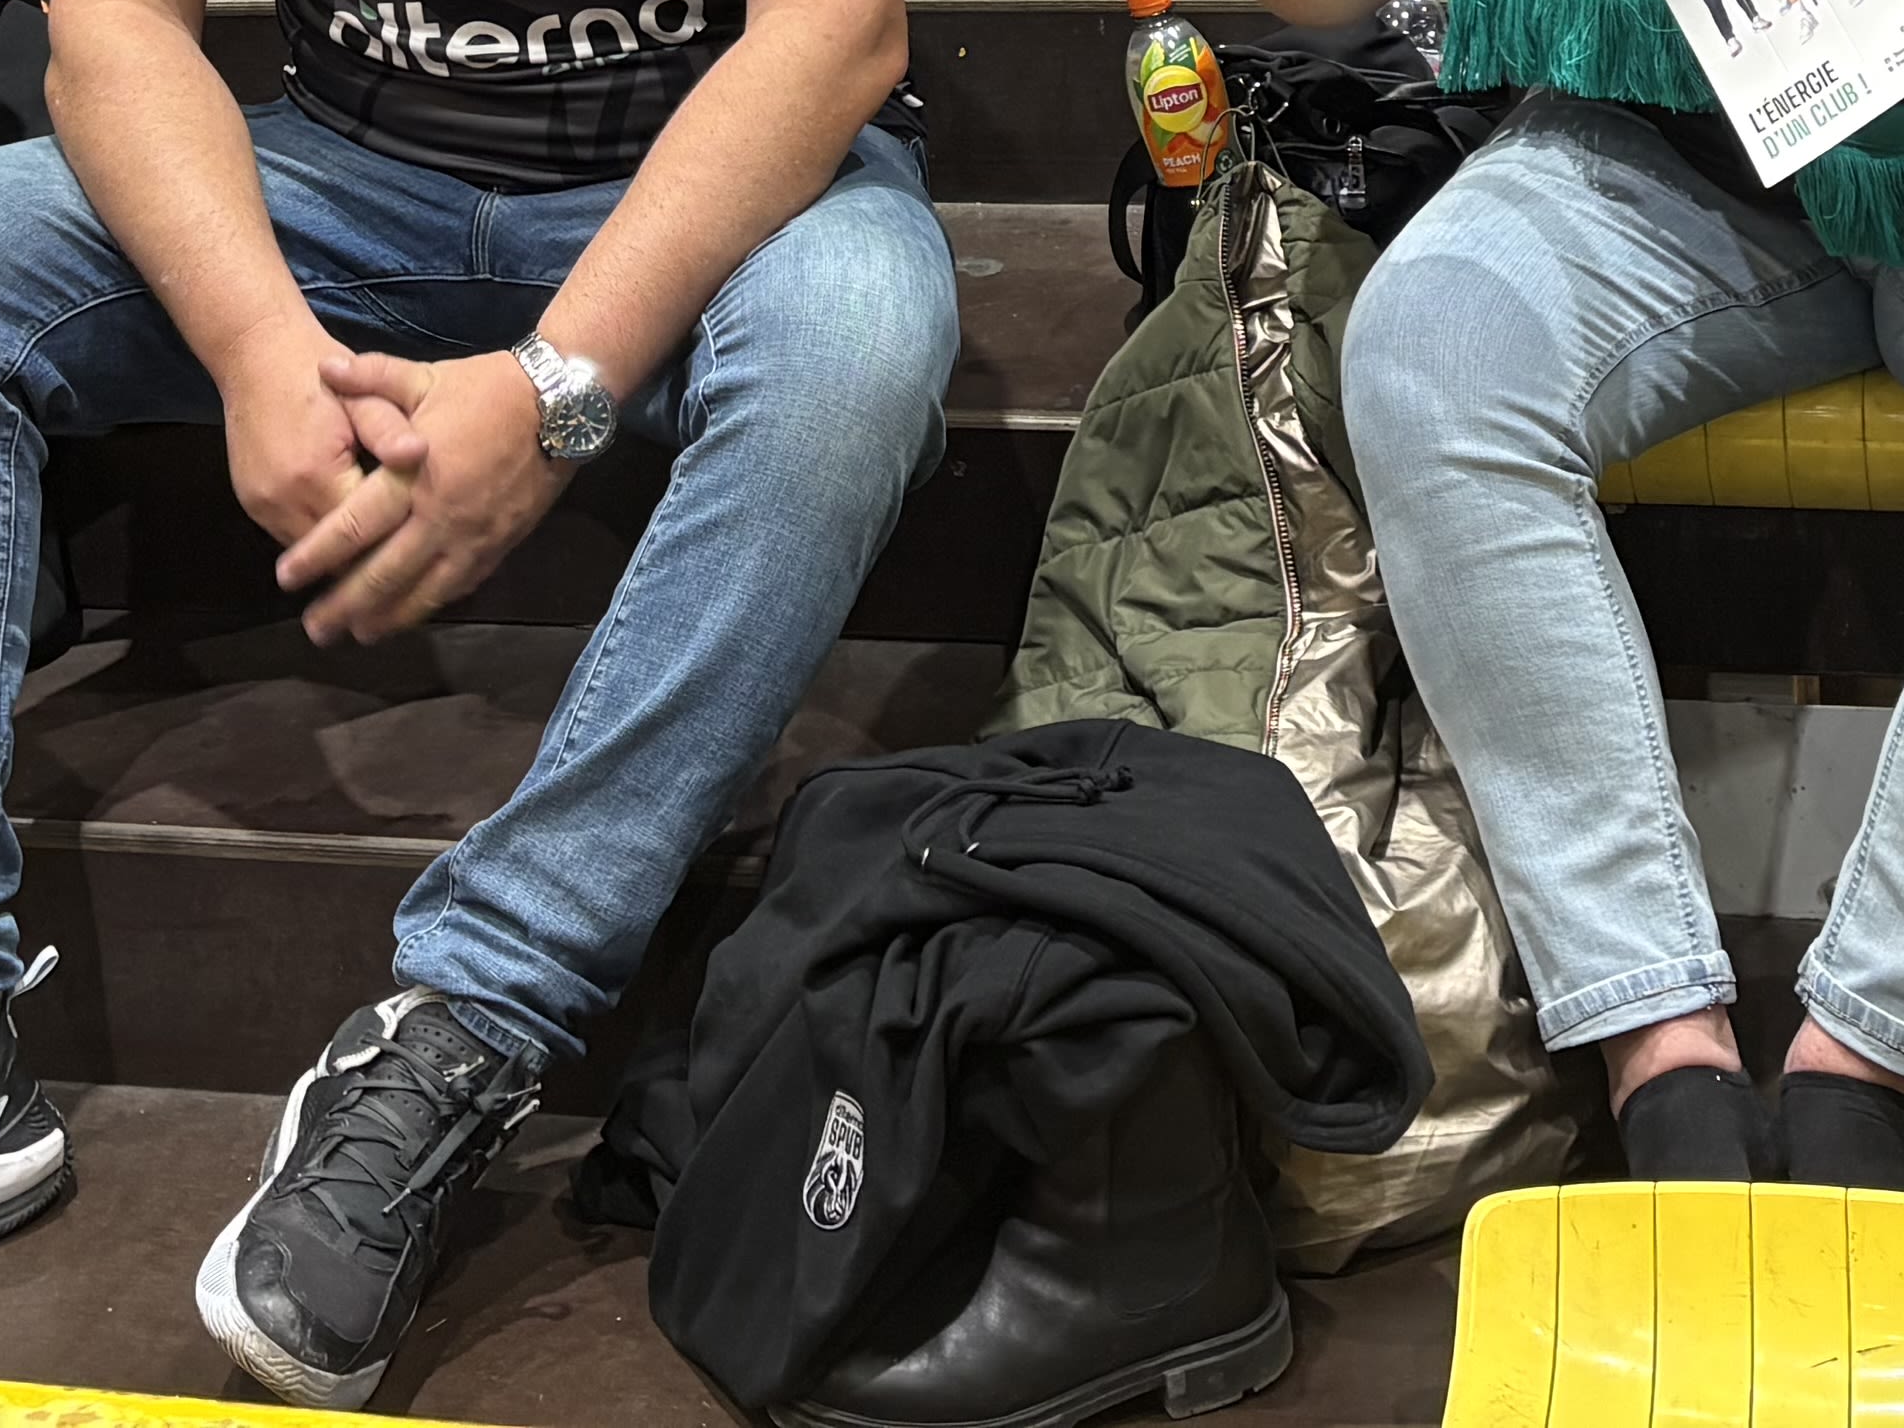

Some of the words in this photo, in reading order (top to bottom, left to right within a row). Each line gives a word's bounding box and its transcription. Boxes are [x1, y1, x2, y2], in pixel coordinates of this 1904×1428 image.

[1151, 87, 1199, 111] Lipton
[1749, 60, 1839, 133] L'ÉNERGIE
[1762, 114, 1811, 159] D'UN
[1810, 81, 1859, 127] CLUB
[1162, 152, 1201, 168] PEACH
